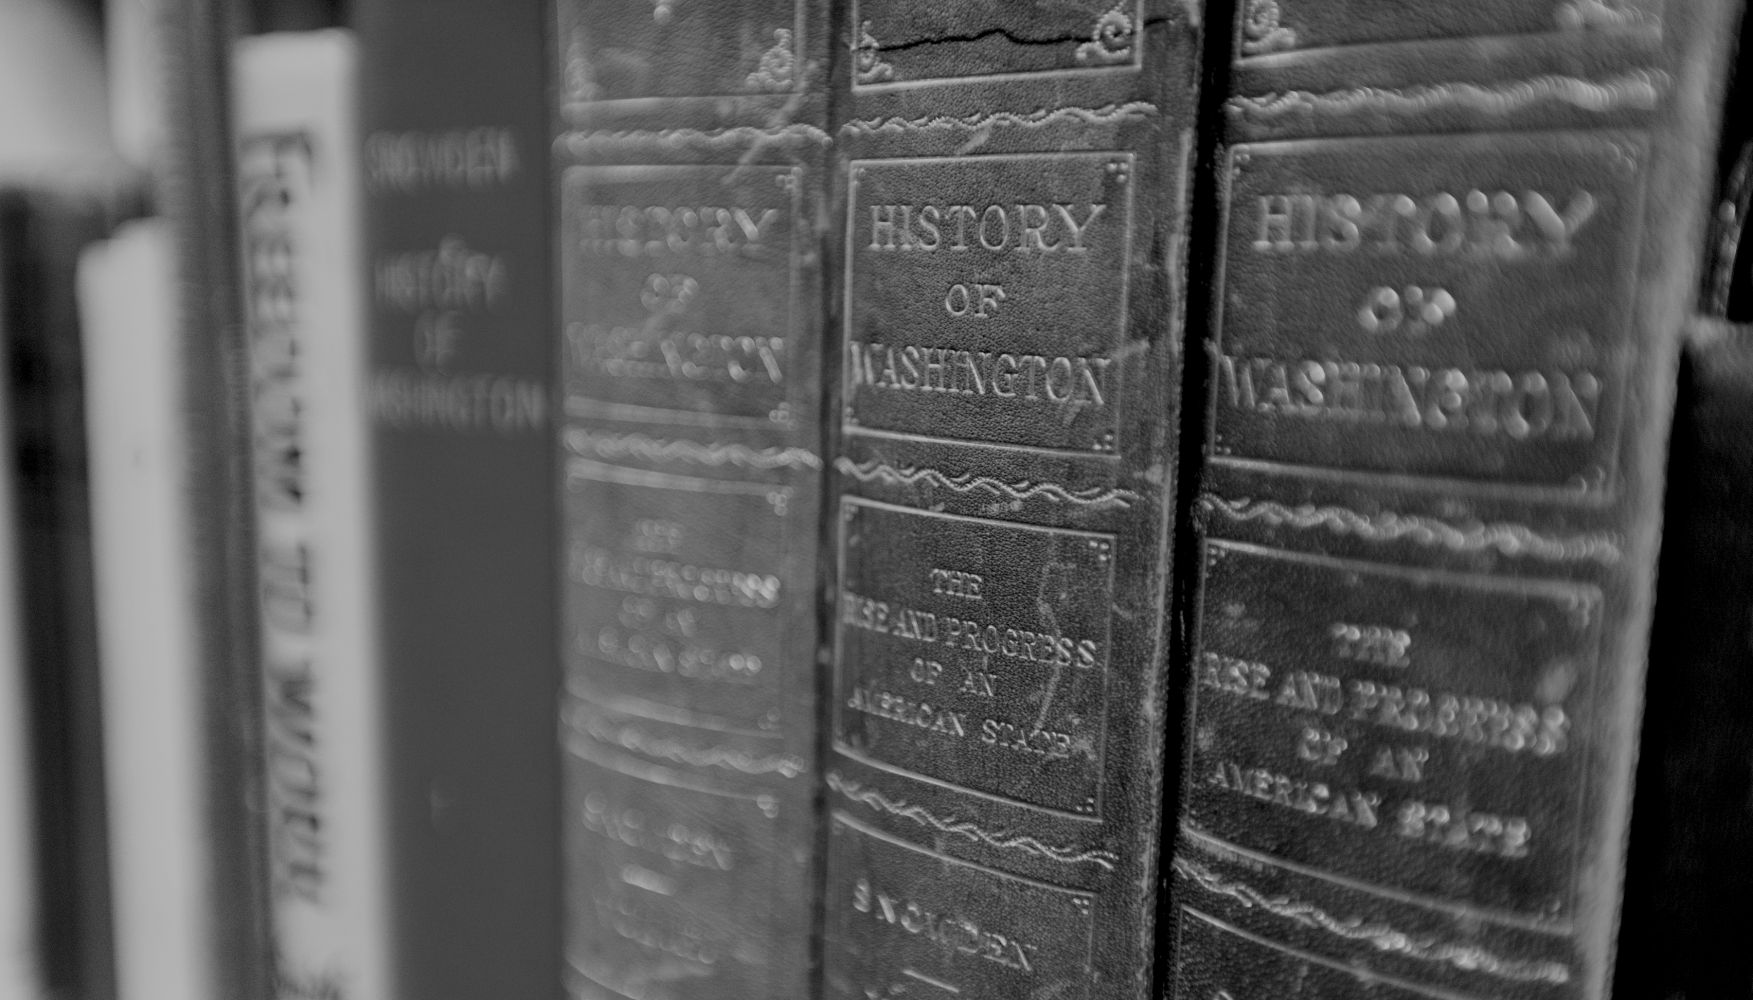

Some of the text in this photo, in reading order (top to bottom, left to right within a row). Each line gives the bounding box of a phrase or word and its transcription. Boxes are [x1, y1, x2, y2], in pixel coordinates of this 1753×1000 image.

[869, 204, 1107, 251] HISTORY
[1252, 189, 1594, 262] HISTORY
[945, 283, 1006, 318] OF
[1358, 285, 1456, 335] OF
[849, 340, 1112, 405] WASHINGTON
[1220, 355, 1600, 440] WASHINGTON
[929, 568, 983, 599] THE
[893, 608, 938, 643] AND
[945, 617, 1097, 669] PROGRESS
[910, 657, 997, 697] OF AN
[1202, 652, 1271, 700] RISE
[1276, 670, 1343, 715] AND
[847, 688, 1071, 759] AMERICAN STATE
[1208, 762, 1382, 828] AMERICAN
[853, 878, 1038, 972] SNOWDEN
